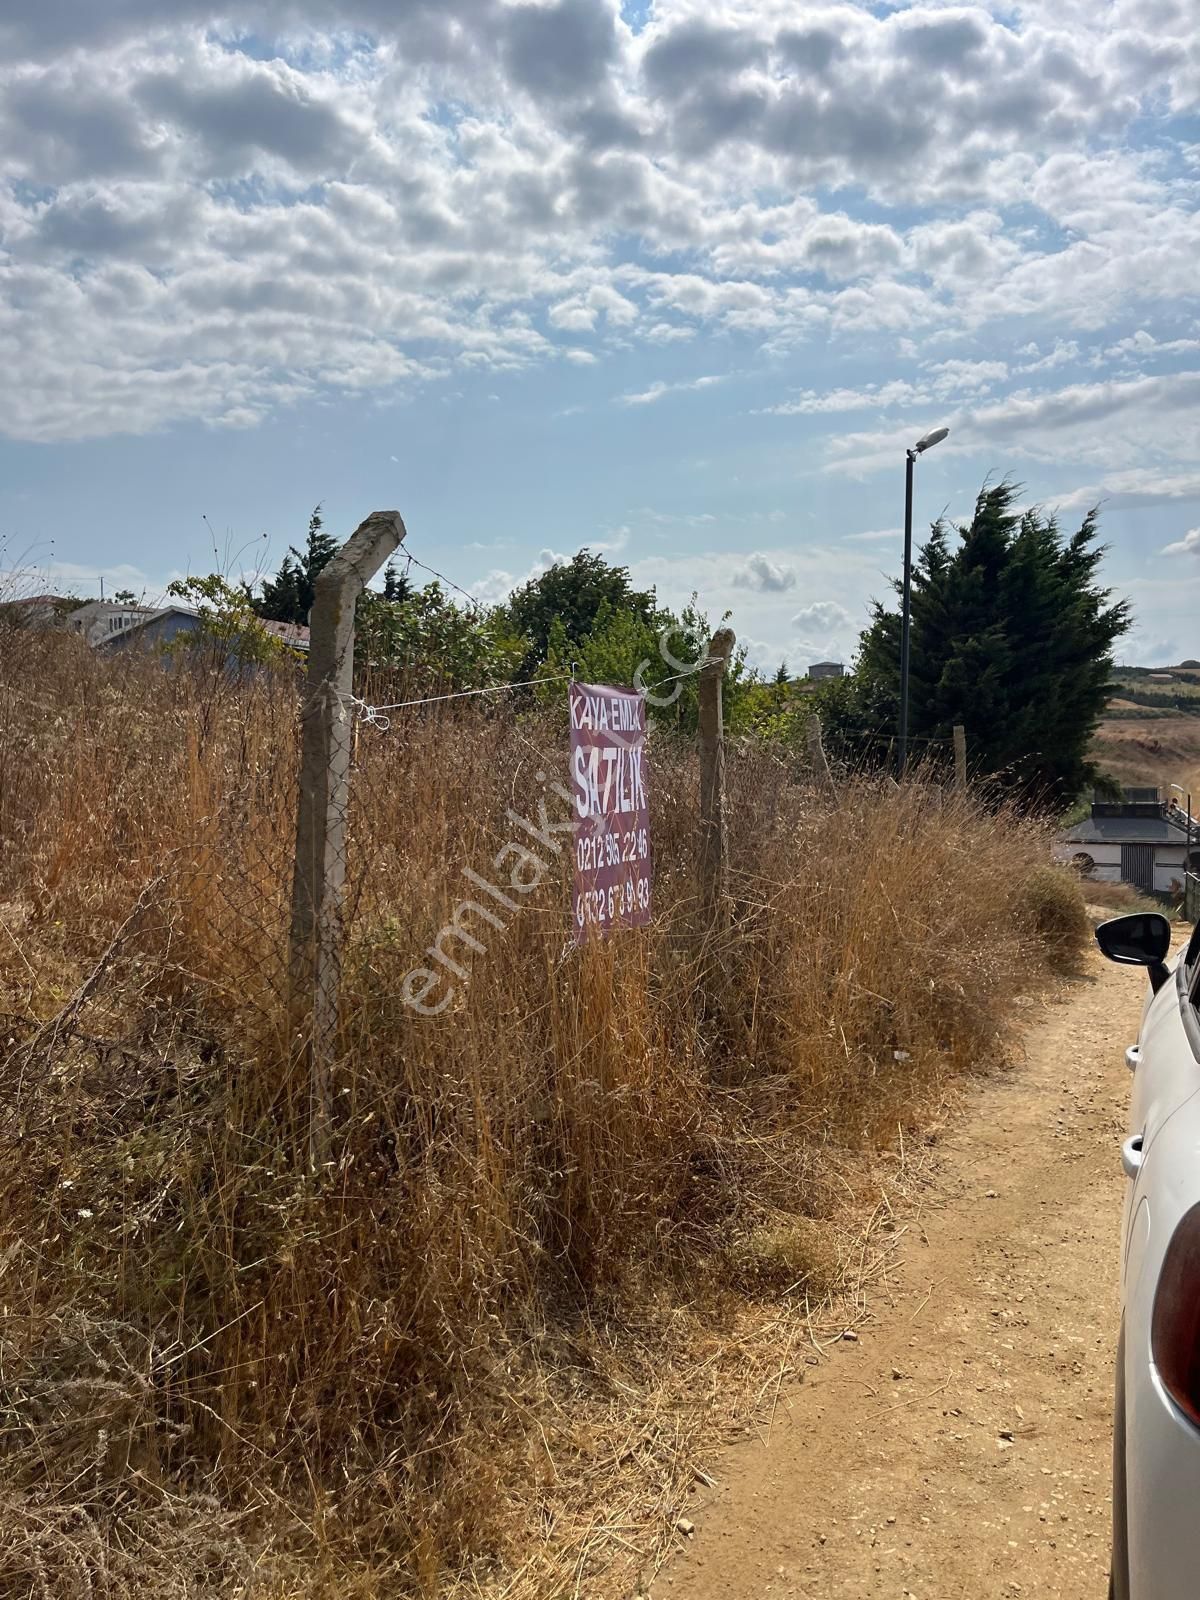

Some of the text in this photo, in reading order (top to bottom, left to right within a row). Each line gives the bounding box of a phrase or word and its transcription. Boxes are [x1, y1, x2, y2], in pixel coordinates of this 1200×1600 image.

[570, 695, 609, 730] KAYA
[575, 745, 646, 818] SATILIK
[577, 835, 605, 872] 0212
[622, 831, 637, 862] 22
